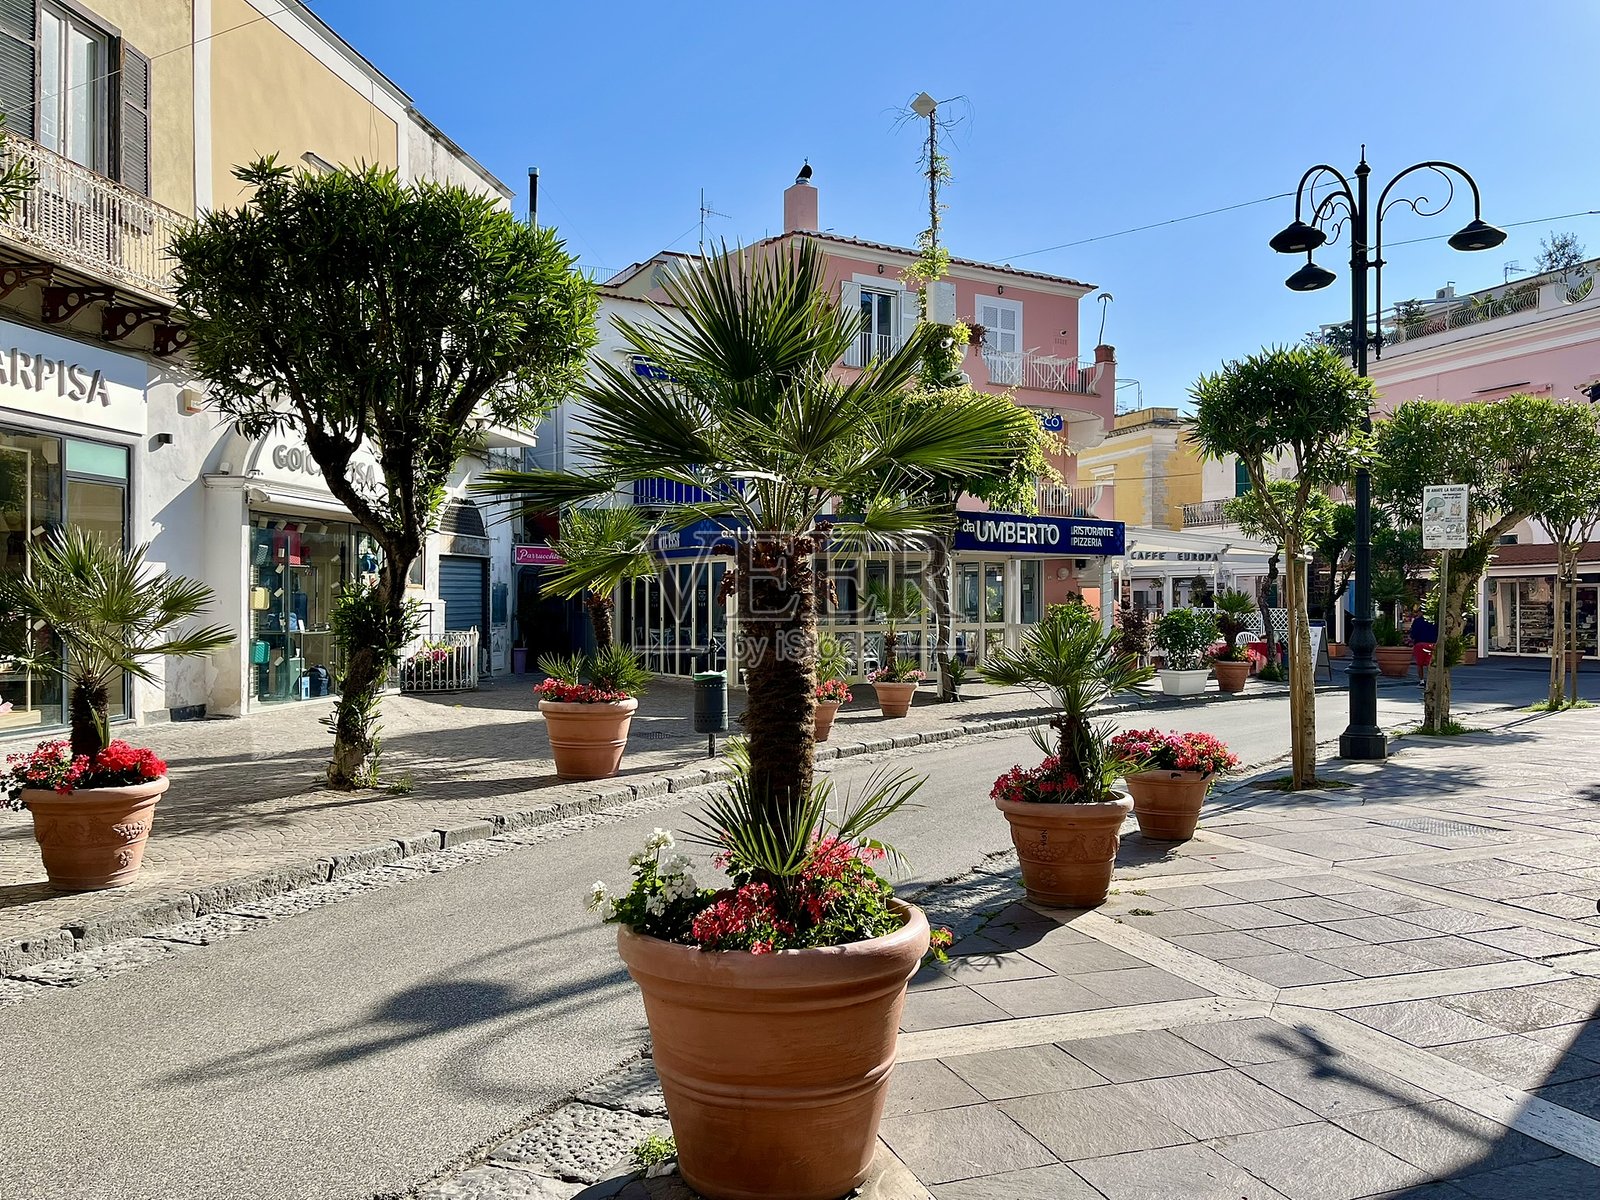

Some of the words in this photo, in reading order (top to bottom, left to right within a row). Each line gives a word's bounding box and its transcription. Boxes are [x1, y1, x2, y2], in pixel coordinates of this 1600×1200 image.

[962, 520, 975, 533] da
[976, 520, 1060, 545] UMBERTO
[1072, 525, 1114, 537] RISTORANTE
[1072, 537, 1103, 547] PIZZERIA
[1131, 551, 1167, 560] CAFFE
[1177, 552, 1219, 561] EUROPA
